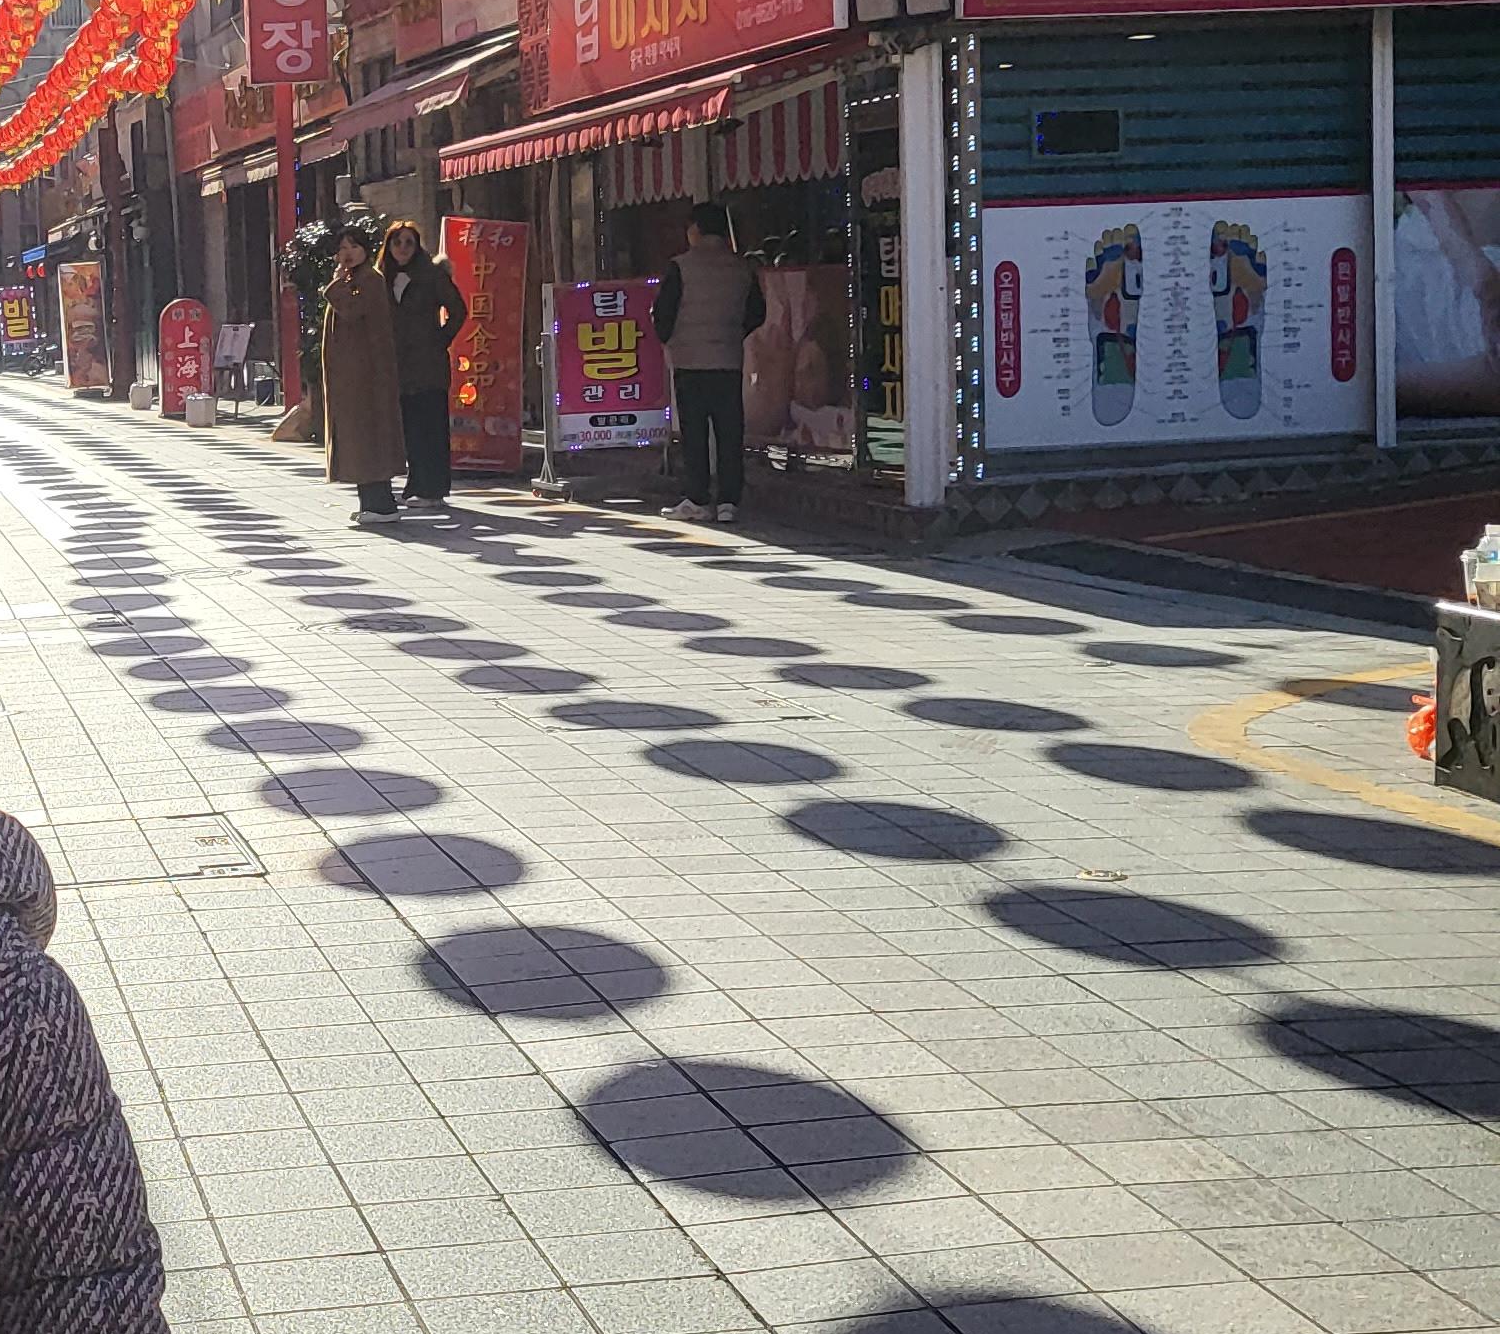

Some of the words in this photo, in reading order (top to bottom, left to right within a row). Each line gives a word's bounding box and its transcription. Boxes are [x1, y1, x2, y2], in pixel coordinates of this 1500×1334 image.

[3, 298, 31, 338] 발
[466, 253, 498, 387] 中国食品
[593, 290, 628, 317] 탑
[577, 320, 644, 380] 발
